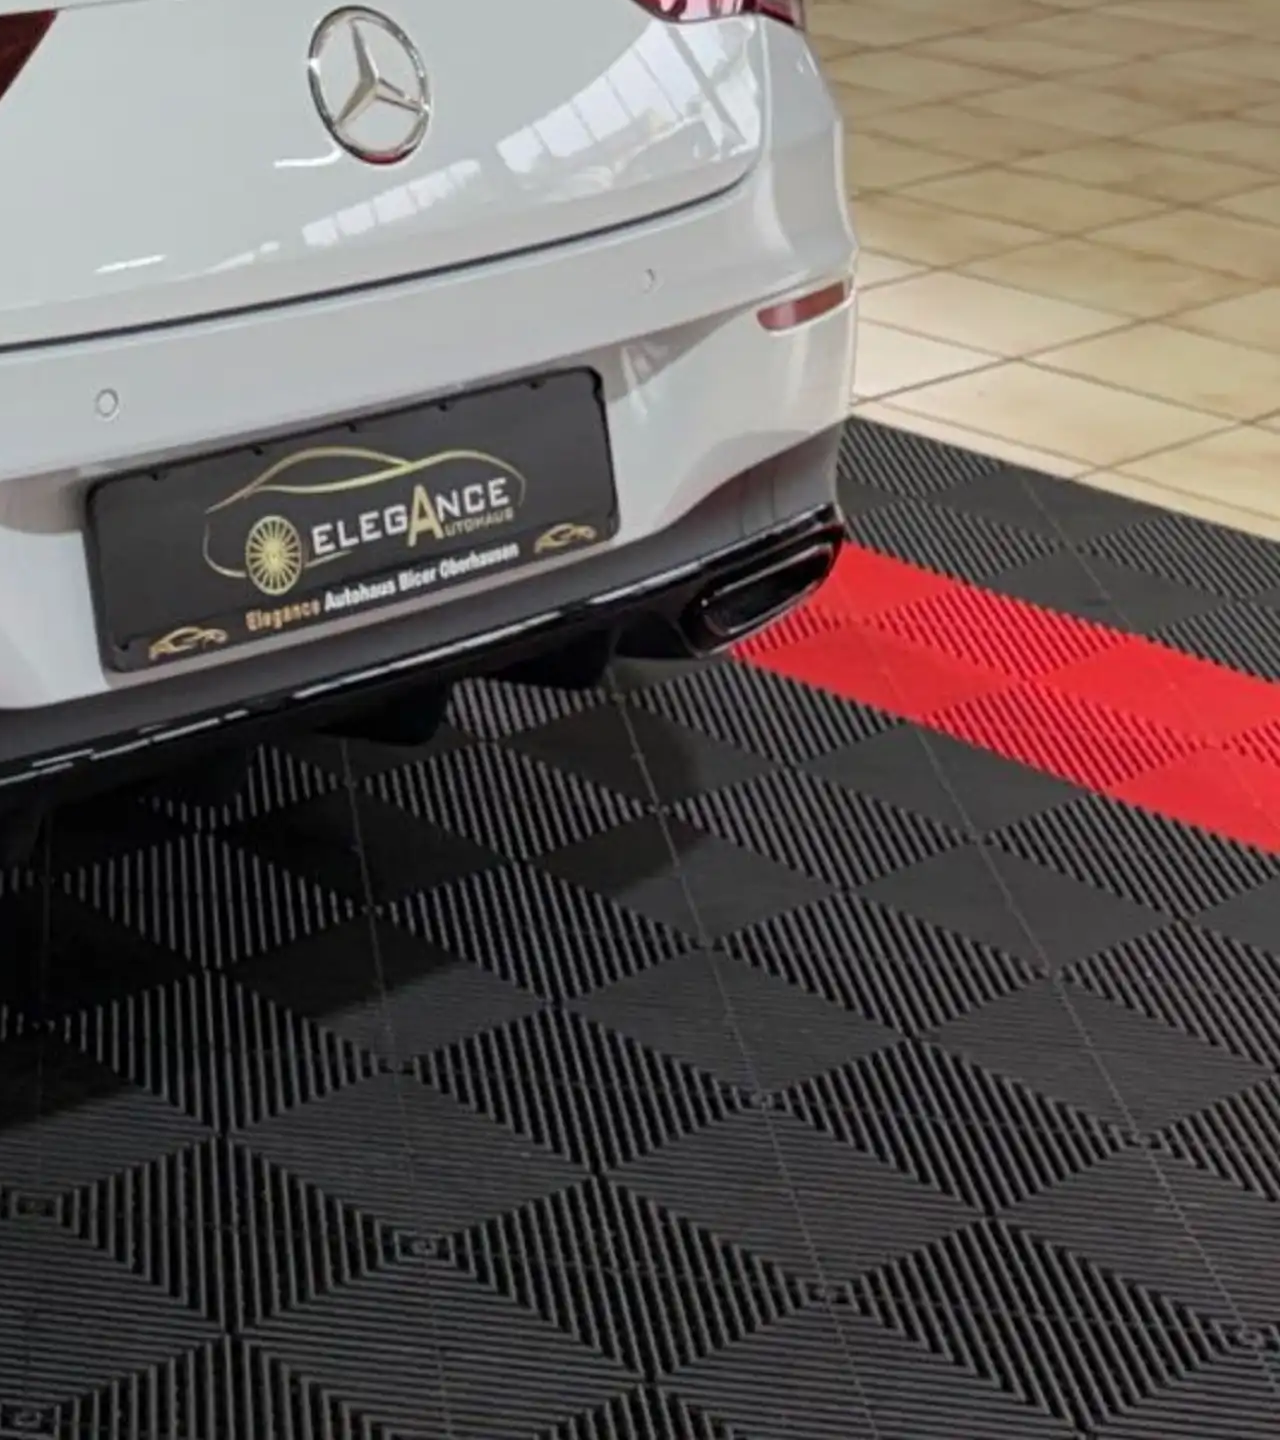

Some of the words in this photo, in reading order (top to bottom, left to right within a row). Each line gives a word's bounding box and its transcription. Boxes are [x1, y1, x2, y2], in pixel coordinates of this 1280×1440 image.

[311, 477, 511, 556] ELEGANCE
[245, 599, 321, 632] Elegance
[323, 579, 397, 612] Autohaus
[438, 542, 521, 579] Oberhausen
